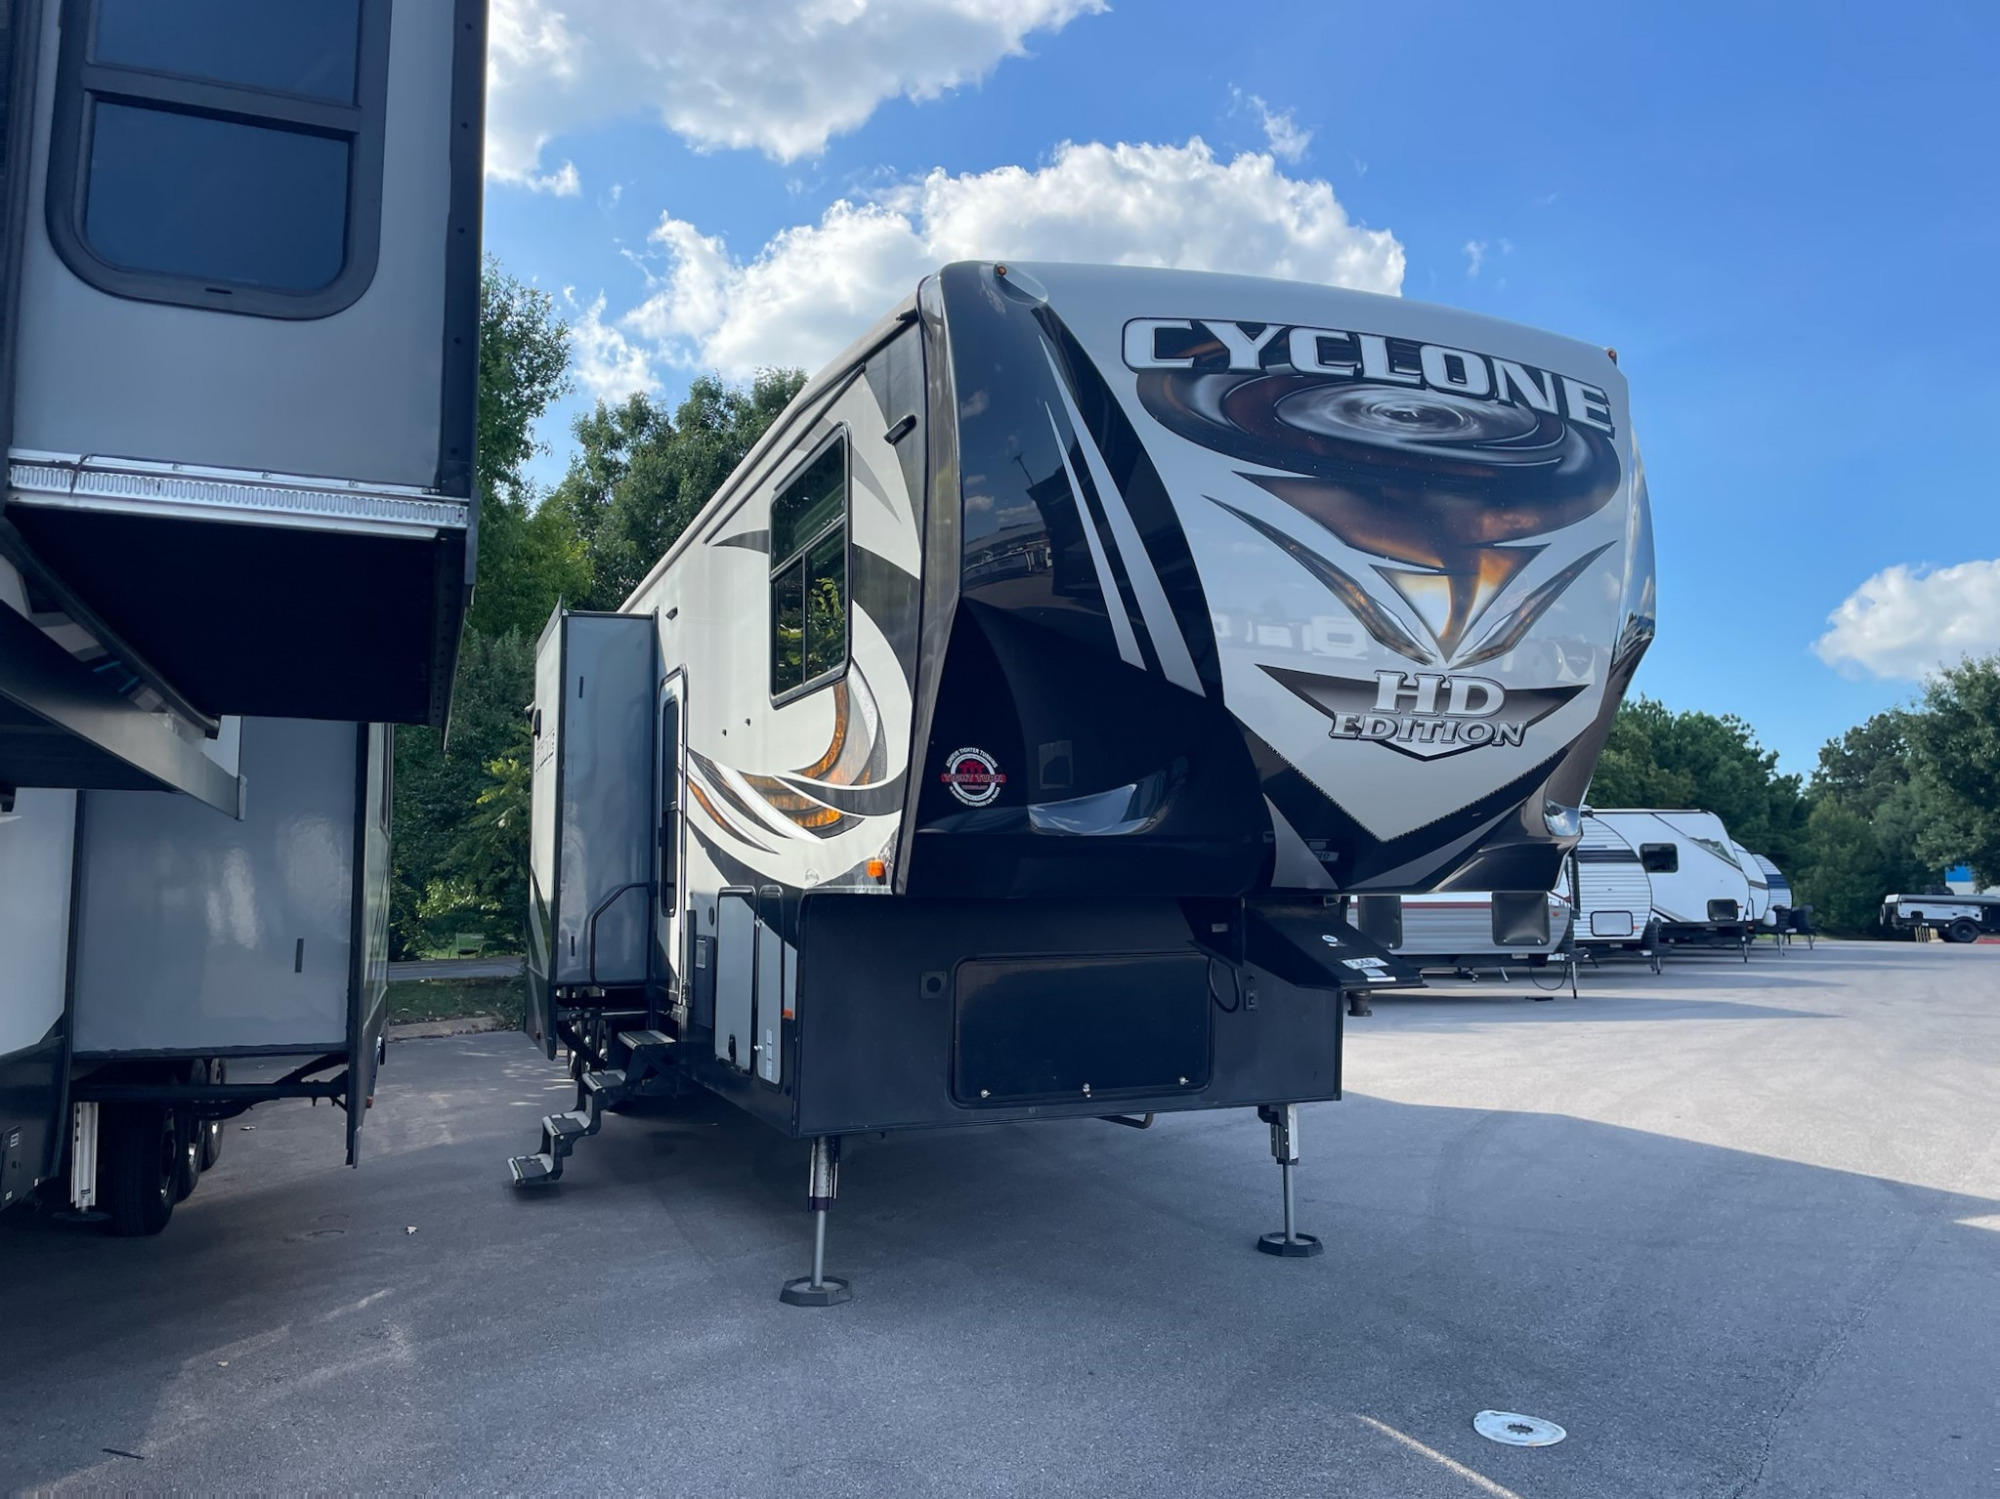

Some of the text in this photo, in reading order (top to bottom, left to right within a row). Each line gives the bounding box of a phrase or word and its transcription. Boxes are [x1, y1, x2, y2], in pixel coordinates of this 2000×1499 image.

[1122, 317, 1615, 438] CYCLONE
[1371, 670, 1506, 719] HD
[1329, 711, 1527, 747] EDITION
